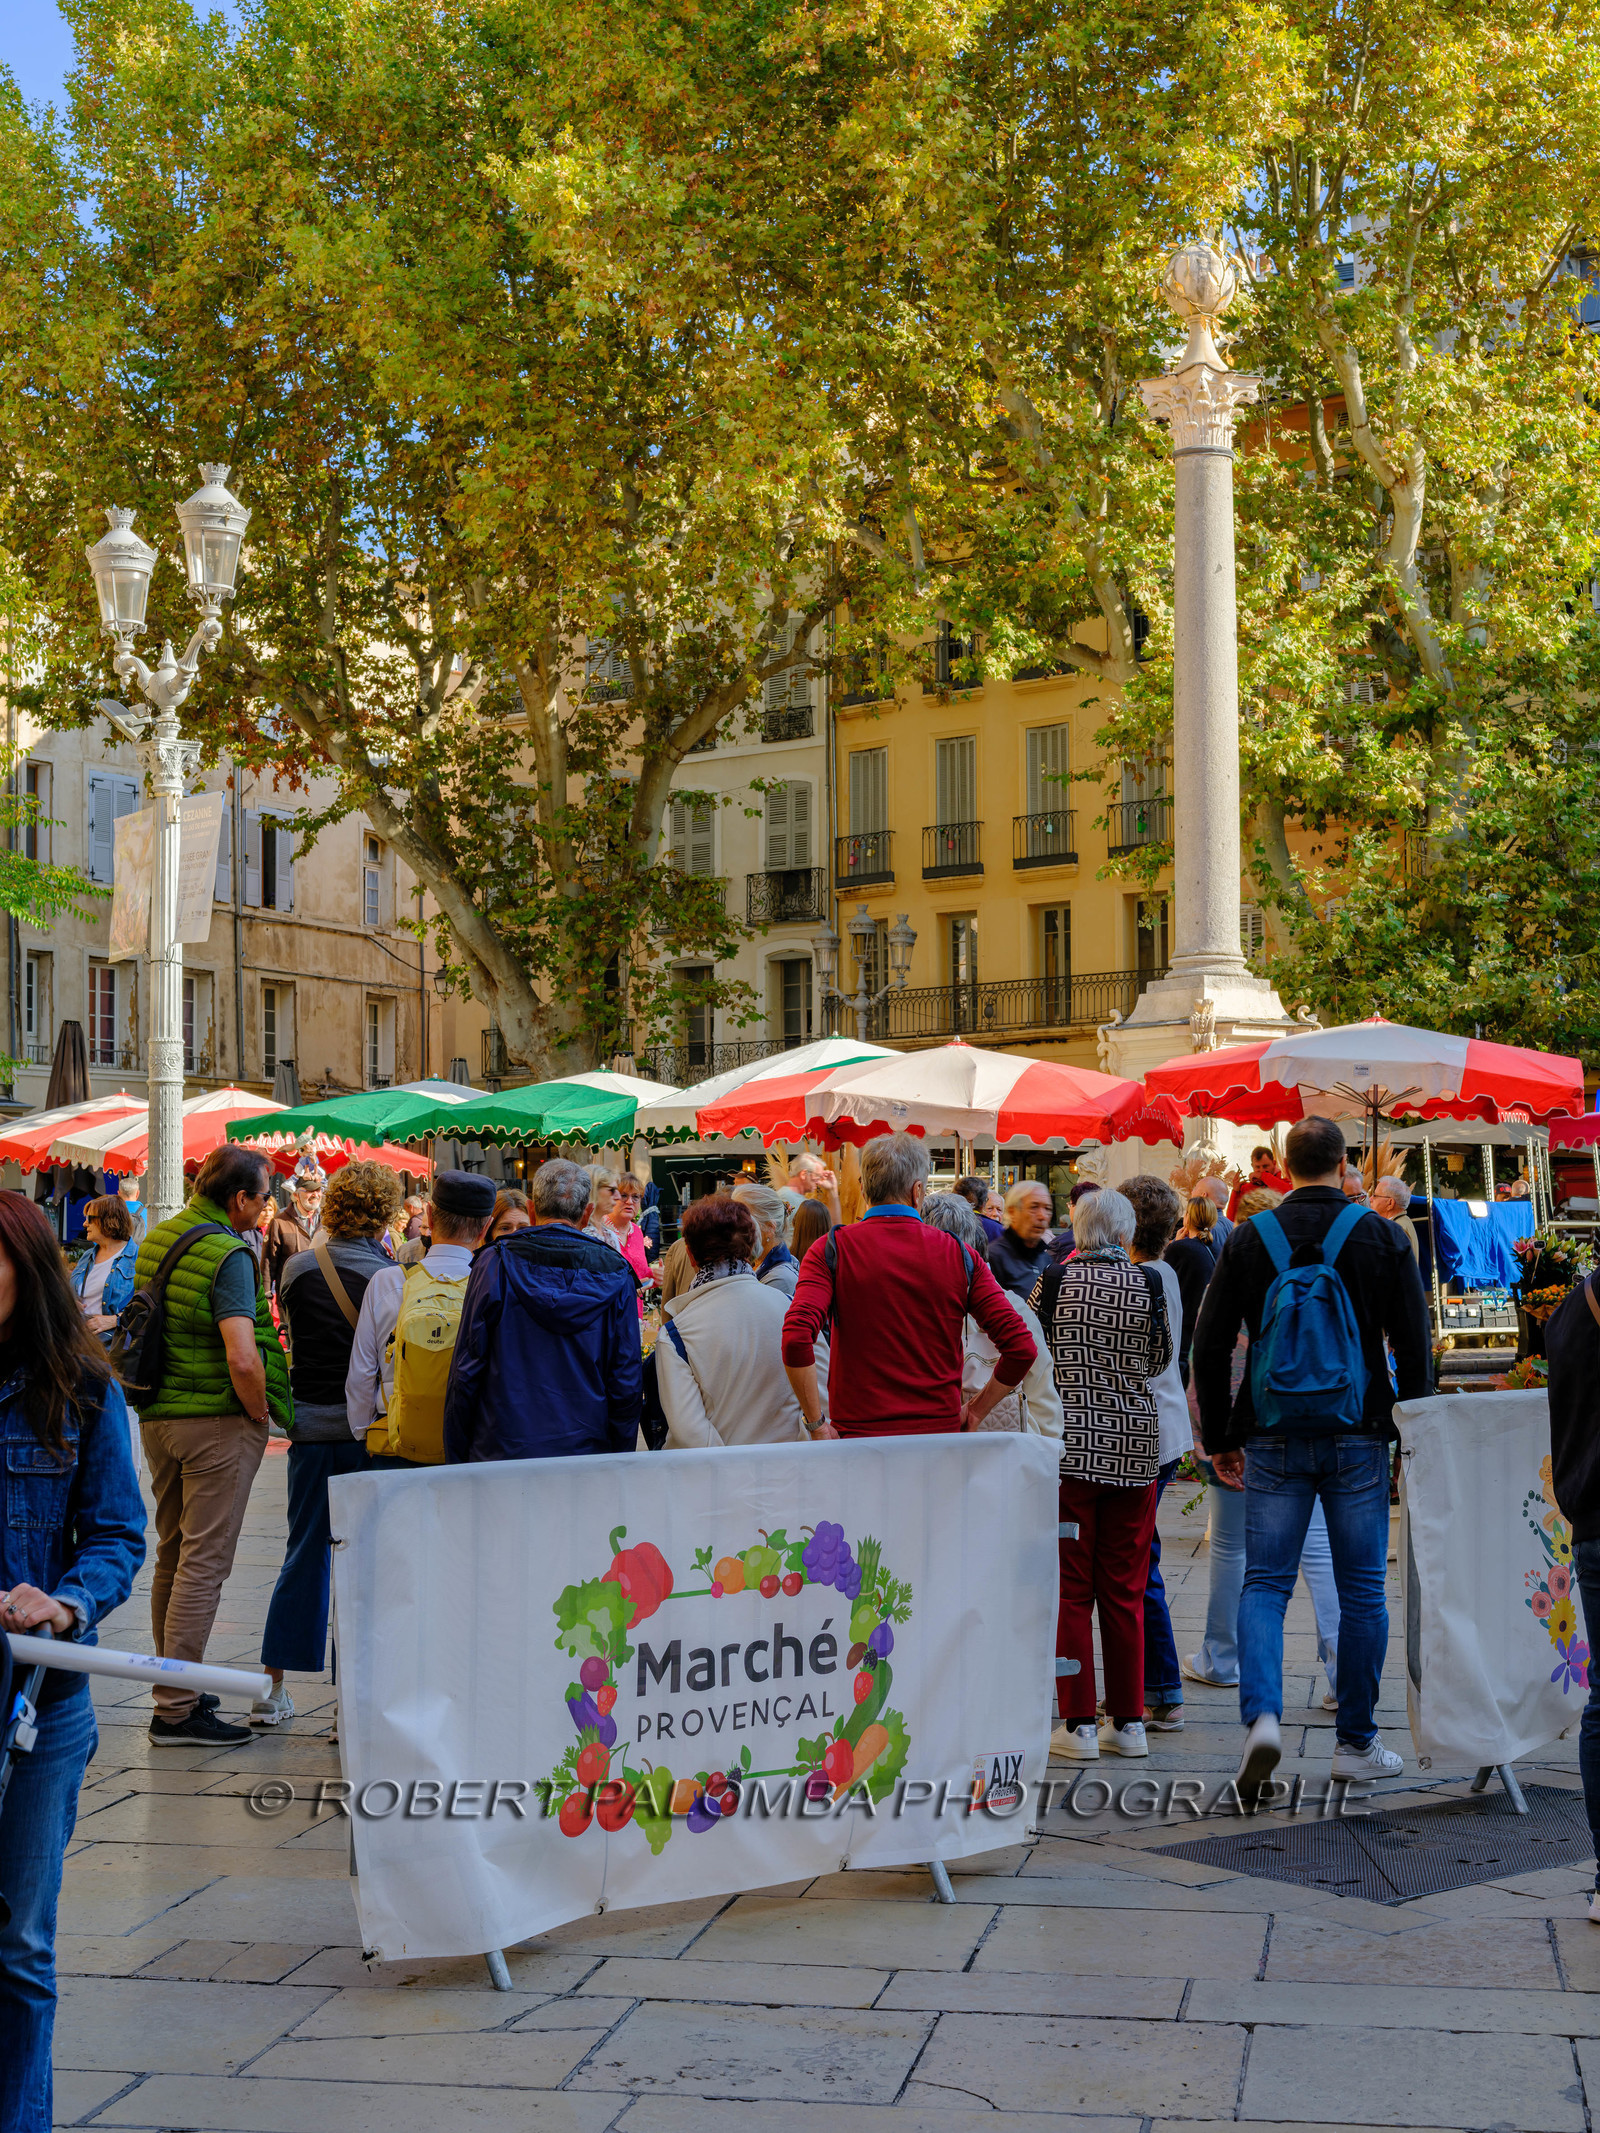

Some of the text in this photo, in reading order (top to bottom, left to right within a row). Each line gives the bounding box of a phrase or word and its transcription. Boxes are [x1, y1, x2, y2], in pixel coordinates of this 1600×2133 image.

[637, 1618, 838, 1697] Marché
[637, 1691, 835, 1743] PROVENÇAL
[989, 1755, 1023, 1790] AIX
